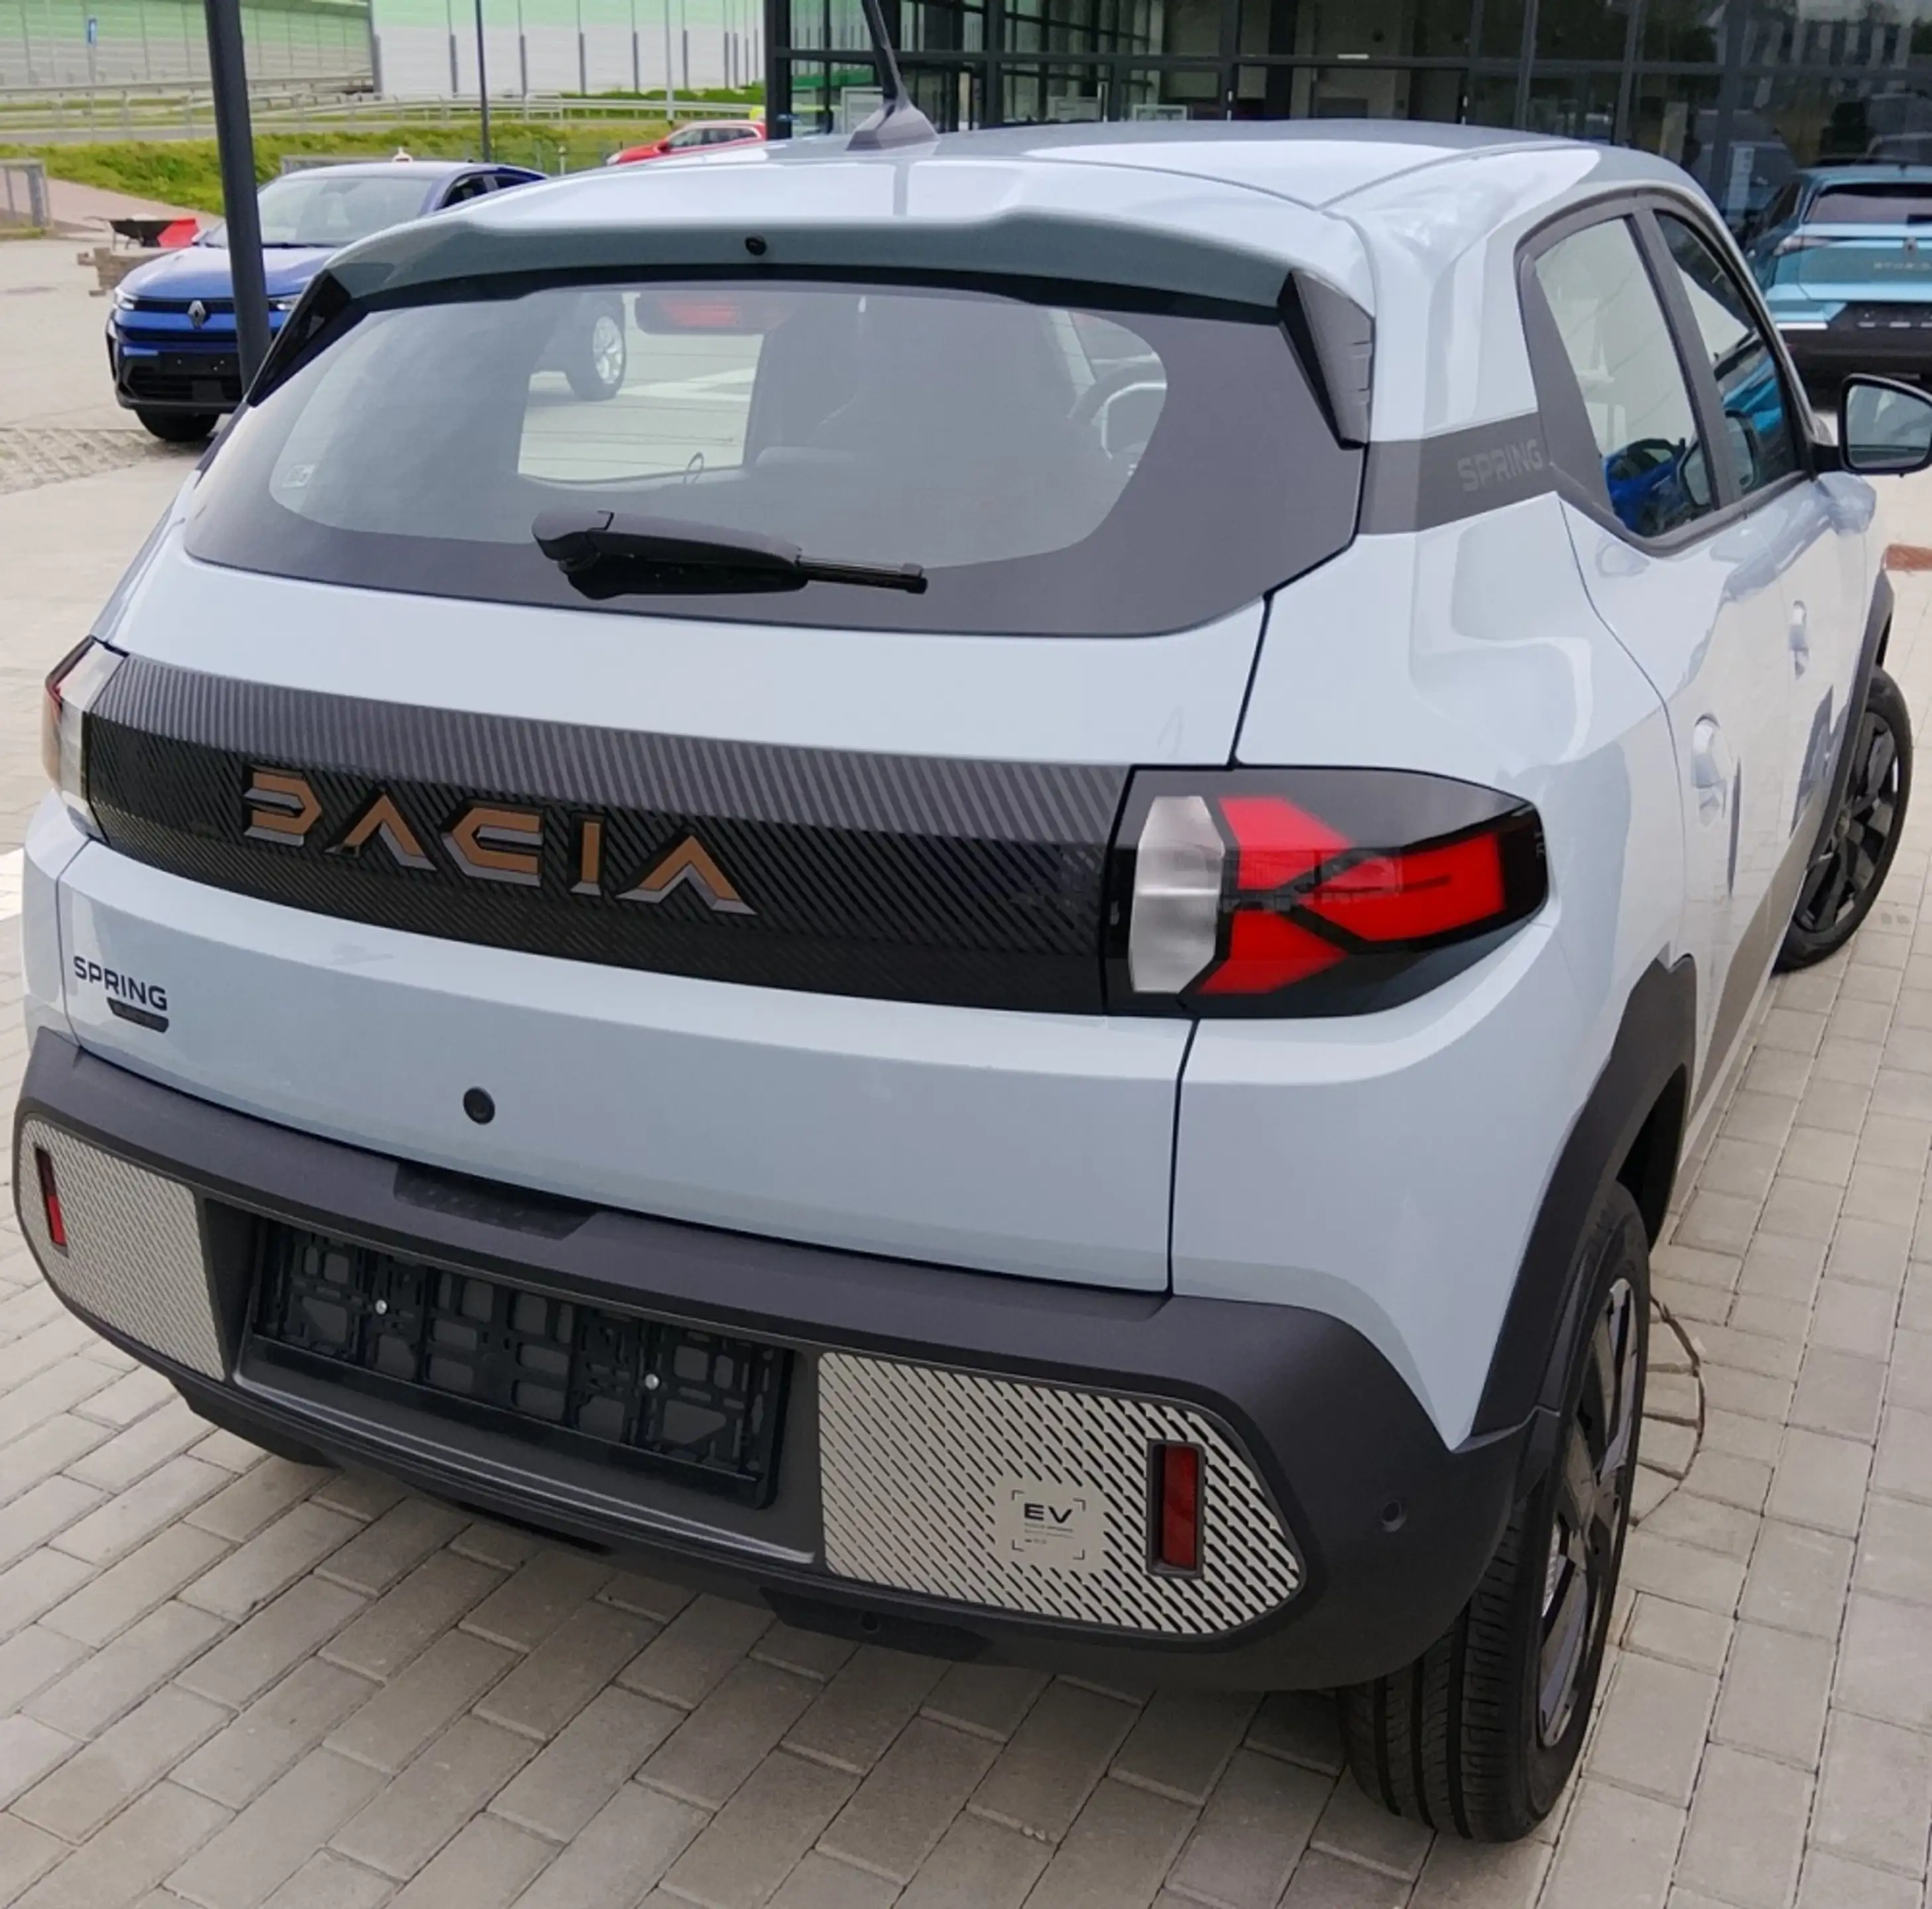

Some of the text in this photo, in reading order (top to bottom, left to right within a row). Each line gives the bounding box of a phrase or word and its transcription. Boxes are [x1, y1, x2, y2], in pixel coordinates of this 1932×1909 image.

[1457, 439, 1543, 492] SPRING
[243, 767, 758, 915] DACIA
[73, 956, 168, 1012] SPRING
[1024, 1503, 1073, 1523] EV
